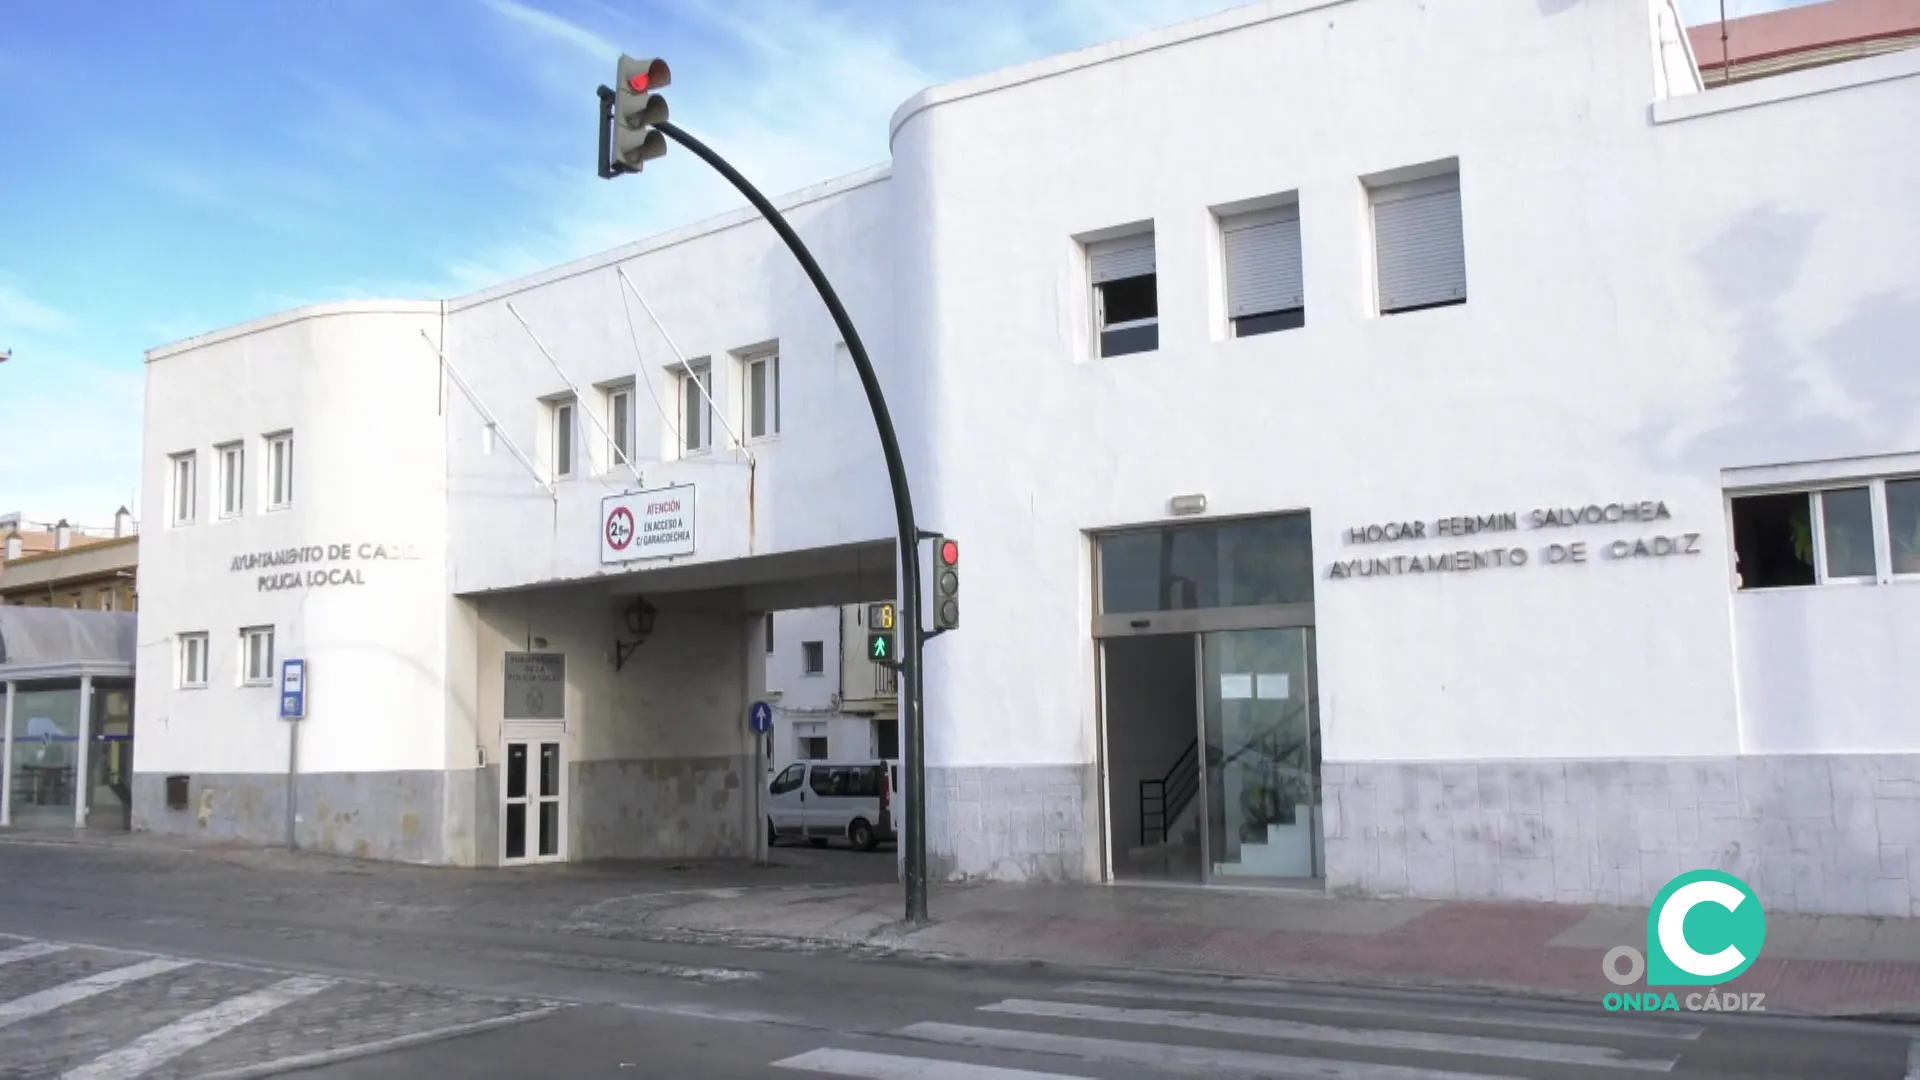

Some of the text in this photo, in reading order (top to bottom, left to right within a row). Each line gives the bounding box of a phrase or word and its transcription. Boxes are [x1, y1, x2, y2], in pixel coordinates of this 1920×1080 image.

[647, 499, 680, 515] ATENCIÓN
[644, 518, 683, 532] EN ACCESO A
[1349, 500, 1672, 544] HOGAR FERMIN SALVOCHEA
[230, 546, 324, 571] AYUNTAMIENTO
[327, 544, 351, 560] DE
[1329, 533, 1702, 579] AYUNTAMIENTO DE CADIZ
[306, 569, 365, 587] LOCAL
